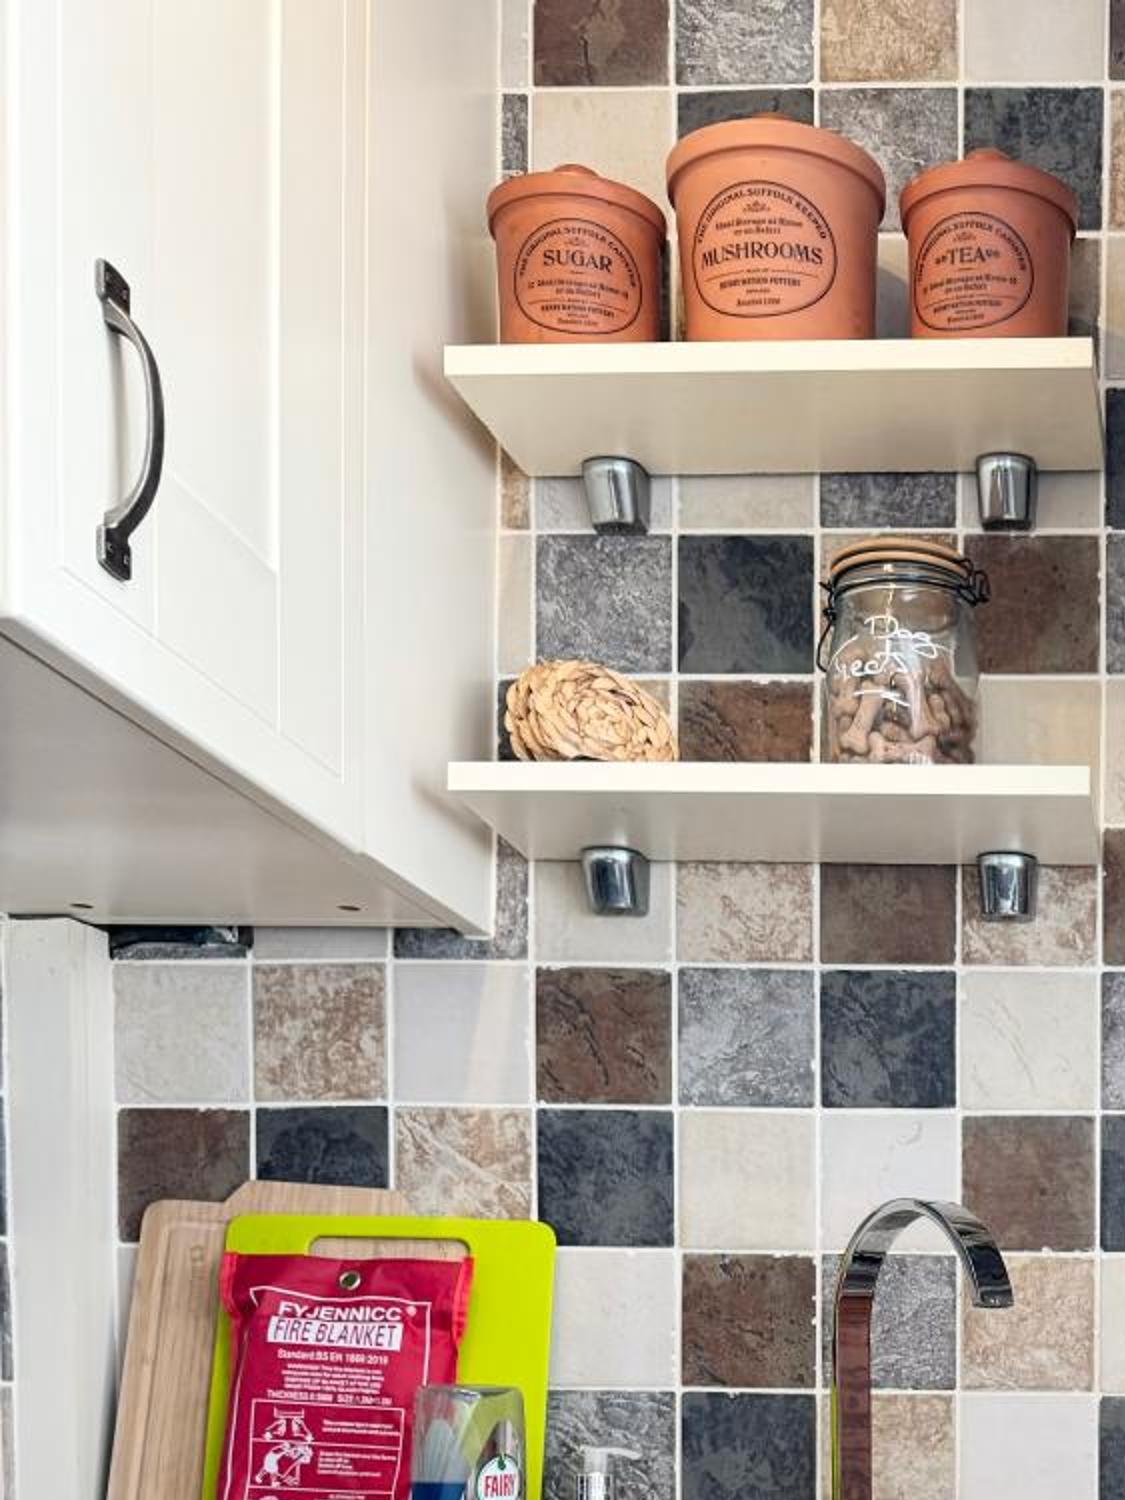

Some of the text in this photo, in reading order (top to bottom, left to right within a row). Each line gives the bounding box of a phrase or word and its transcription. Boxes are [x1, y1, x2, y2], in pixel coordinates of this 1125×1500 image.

[543, 249, 613, 274] SUGAR
[701, 241, 823, 269] MUSHROOMS
[946, 247, 987, 265] TEA
[863, 613, 940, 659] Dog
[273, 1318, 398, 1348] FIRE BLANKET
[483, 1474, 515, 1498] FAIRY
